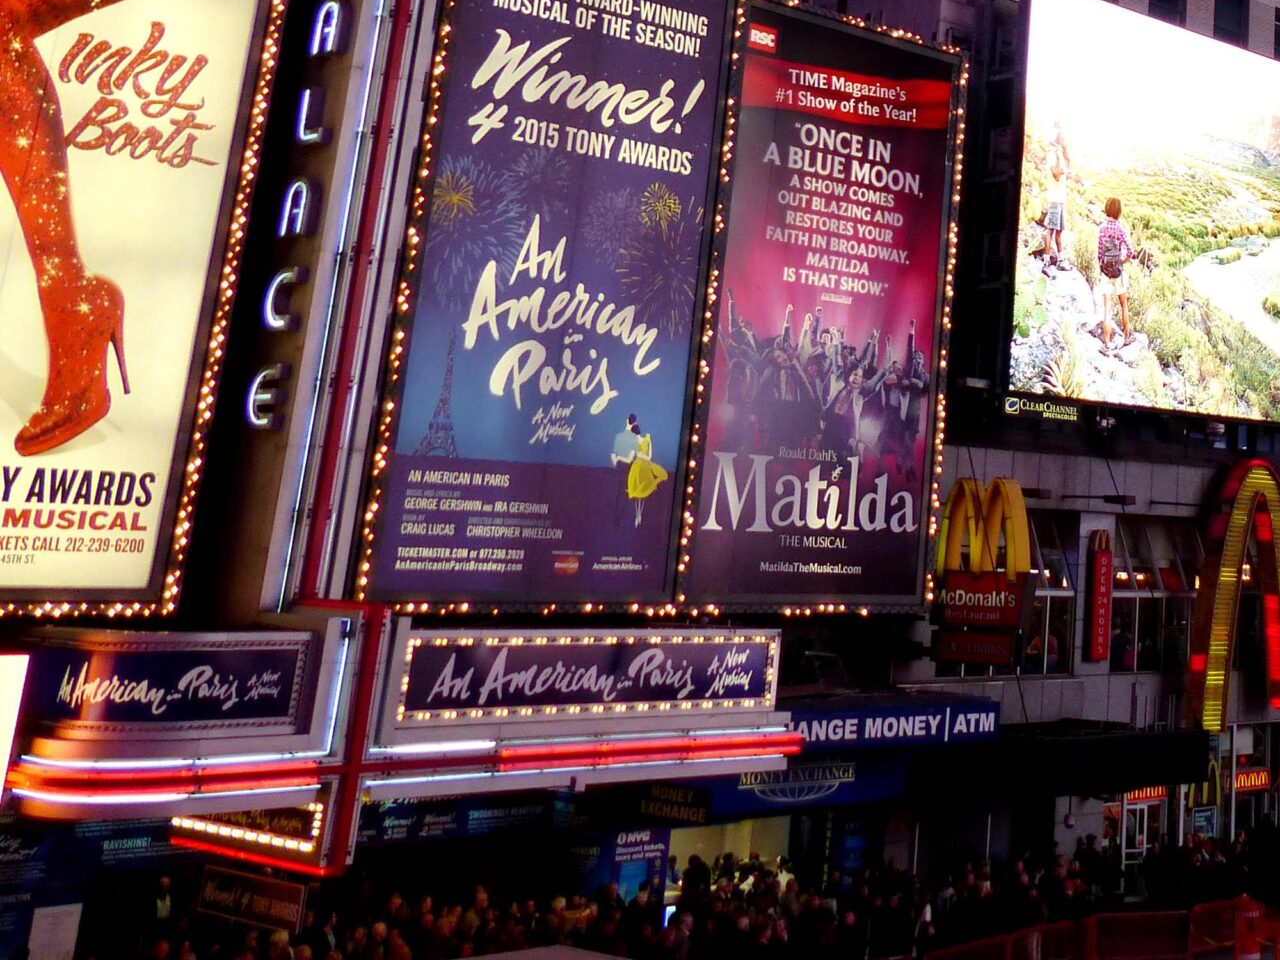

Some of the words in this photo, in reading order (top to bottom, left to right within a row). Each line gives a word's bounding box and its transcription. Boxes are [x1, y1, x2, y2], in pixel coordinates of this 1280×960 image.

[575, 7, 600, 30] OF
[602, 13, 631, 41] THE
[635, 22, 700, 58] SEASON!
[750, 28, 776, 48] RSC
[471, 28, 705, 134] Winner!
[789, 69, 828, 90] TIME
[831, 75, 907, 102] Magazine's
[775, 88, 794, 105] #1
[798, 91, 838, 110] Show
[841, 98, 857, 114] of
[858, 101, 880, 118] the
[883, 104, 917, 122] Year!
[66, 97, 220, 169] Boots
[468, 103, 508, 144] 4
[512, 116, 559, 149] 2015
[565, 126, 616, 159] TONY
[618, 138, 693, 176] AWARDS
[868, 138, 892, 163] IN
[763, 142, 781, 166] A
[788, 147, 845, 179] BLUE
[851, 161, 923, 199] MOON,
[789, 174, 801, 189] A
[803, 176, 845, 197] SHOW
[849, 186, 895, 207] COMES
[778, 191, 808, 209] OUT
[811, 195, 872, 221] BLAZING
[873, 209, 903, 227] AND
[786, 211, 853, 236] RESTORES
[857, 223, 893, 244] YOUR
[508, 213, 567, 286] An
[766, 225, 808, 246] FAITH
[812, 232, 827, 249] IN
[830, 236, 910, 265] BROADWAY.
[783, 266, 796, 282] IS
[800, 268, 837, 290] THAT
[806, 251, 870, 276] MATILDA
[461, 259, 662, 377] American
[488, 339, 619, 416] Paris
[779, 446, 808, 460] Roald
[808, 448, 838, 462] Dahl's
[26, 467, 156, 507] AWARDS
[408, 470, 422, 483] AN
[424, 471, 471, 487] AMERICAN
[472, 474, 482, 487] IN
[483, 474, 511, 488] PARIS
[701, 451, 919, 534] Matilda
[2, 508, 148, 532] MUSICAL
[404, 497, 439, 511] GEORGE
[440, 499, 483, 513] GERSHWIN
[494, 500, 508, 514] IRA
[32, 537, 61, 552] CALL
[65, 536, 145, 554] 212-239-6200
[428, 523, 456, 537] LUCAS
[779, 534, 801, 548] THE
[803, 535, 848, 550] MUSICAL
[760, 561, 862, 575] MatildaTheMusical.com
[1100, 556, 1108, 593] OPEN
[938, 589, 1016, 609] McDonald's
[1098, 608, 1106, 654] HOURS
[721, 646, 751, 669] New
[56, 664, 71, 703] An
[71, 661, 168, 714] American
[179, 664, 239, 710] Paris
[427, 653, 475, 704] An
[479, 647, 620, 705] American
[629, 647, 697, 699] Paris
[705, 669, 754, 698] Musical
[864, 715, 941, 739] MONEY
[953, 712, 996, 735] ATM
[740, 769, 787, 787] MONEY
[788, 764, 857, 782] EXCHANGE
[650, 784, 694, 803] MONEY
[640, 800, 706, 822] EXCHANGE
[103, 837, 153, 850] RAVISHING!
